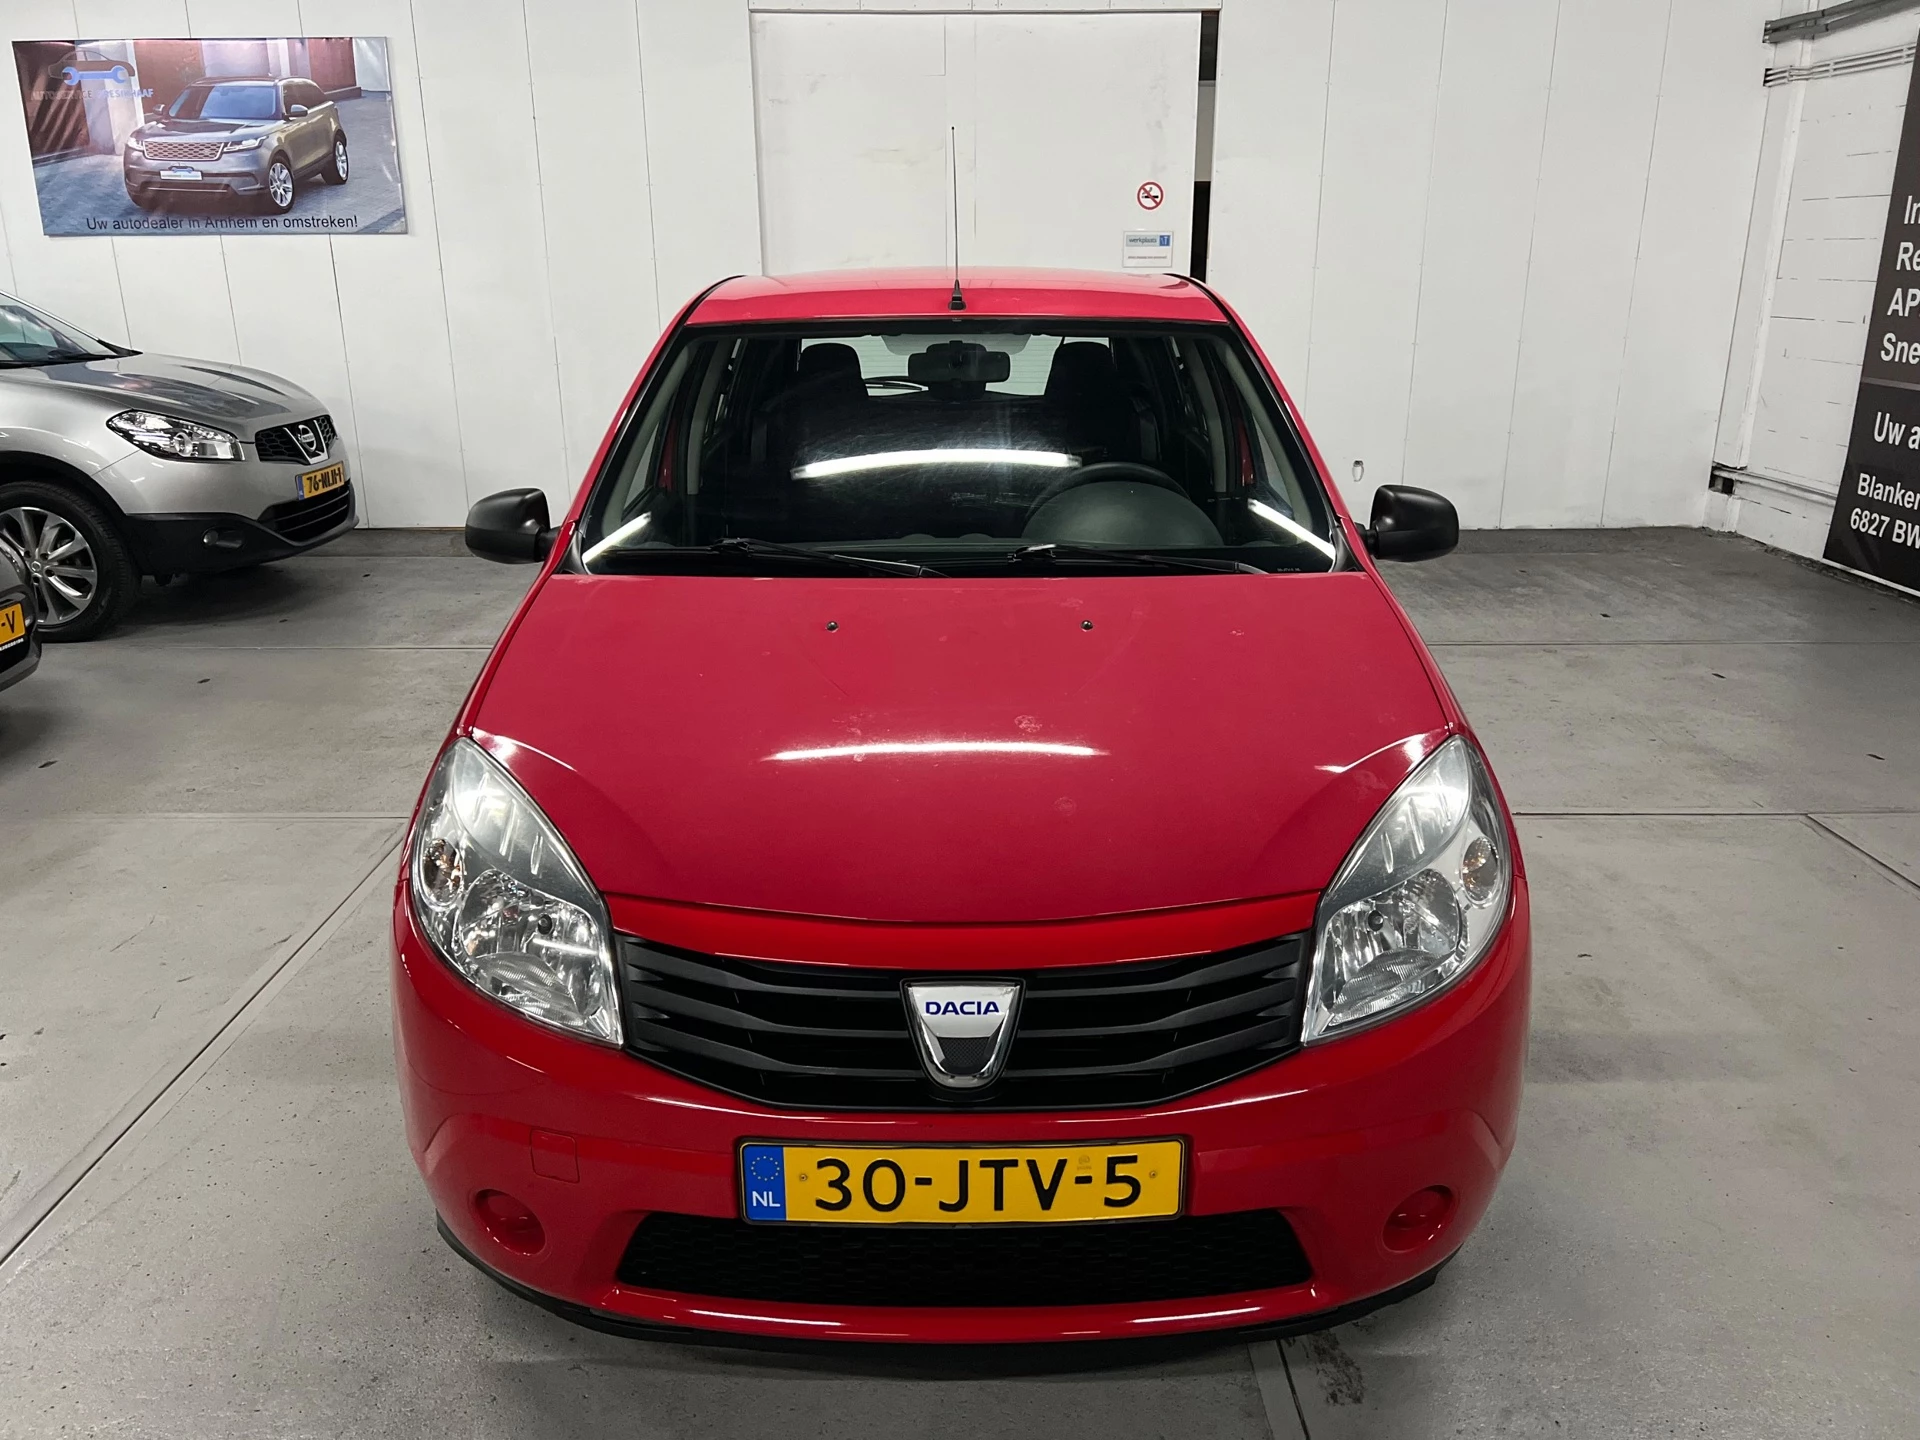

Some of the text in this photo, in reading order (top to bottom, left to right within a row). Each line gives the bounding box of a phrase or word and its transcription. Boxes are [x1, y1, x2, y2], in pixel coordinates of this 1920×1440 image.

[86, 215, 358, 230] Uw autodealer in Arnhem en omstreken!
[1887, 288, 1920, 317] AP
[1874, 411, 1906, 446] Uw
[1850, 507, 1890, 538] 6827
[925, 1001, 1000, 1015] DACIA
[814, 1154, 1142, 1213] 30-JTV-5
[752, 1190, 781, 1207] NL
